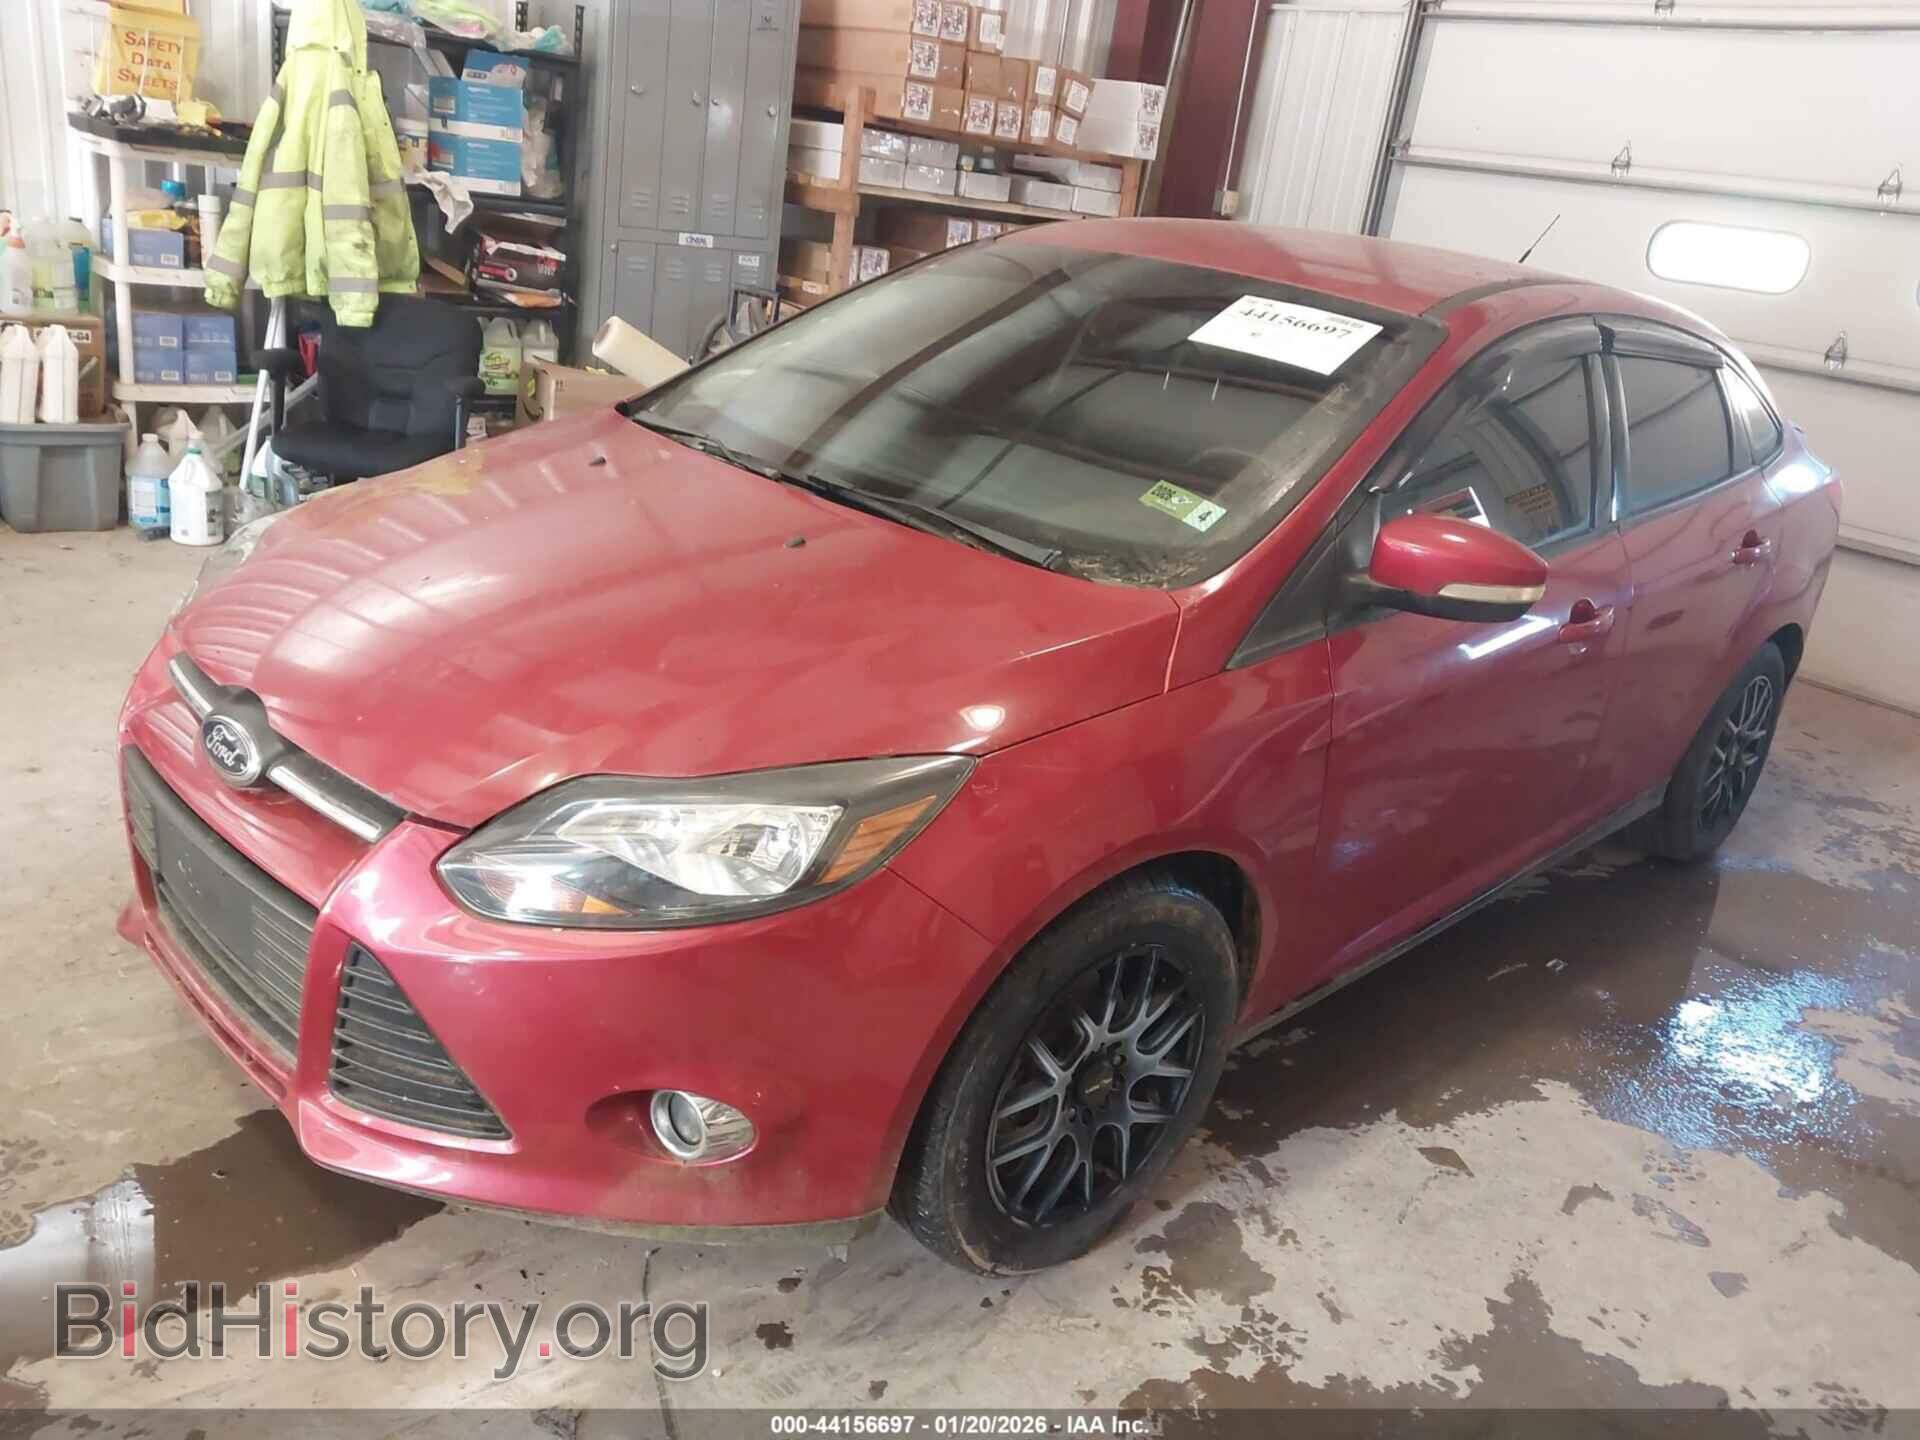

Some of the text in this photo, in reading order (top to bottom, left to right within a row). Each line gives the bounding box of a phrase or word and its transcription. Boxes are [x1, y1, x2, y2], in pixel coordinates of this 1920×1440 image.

[124, 31, 181, 54] SAFETY
[131, 51, 172, 70] DATA
[117, 68, 178, 90] SHEETS
[1240, 307, 1352, 340] 44156697
[206, 724, 241, 767] Ford
